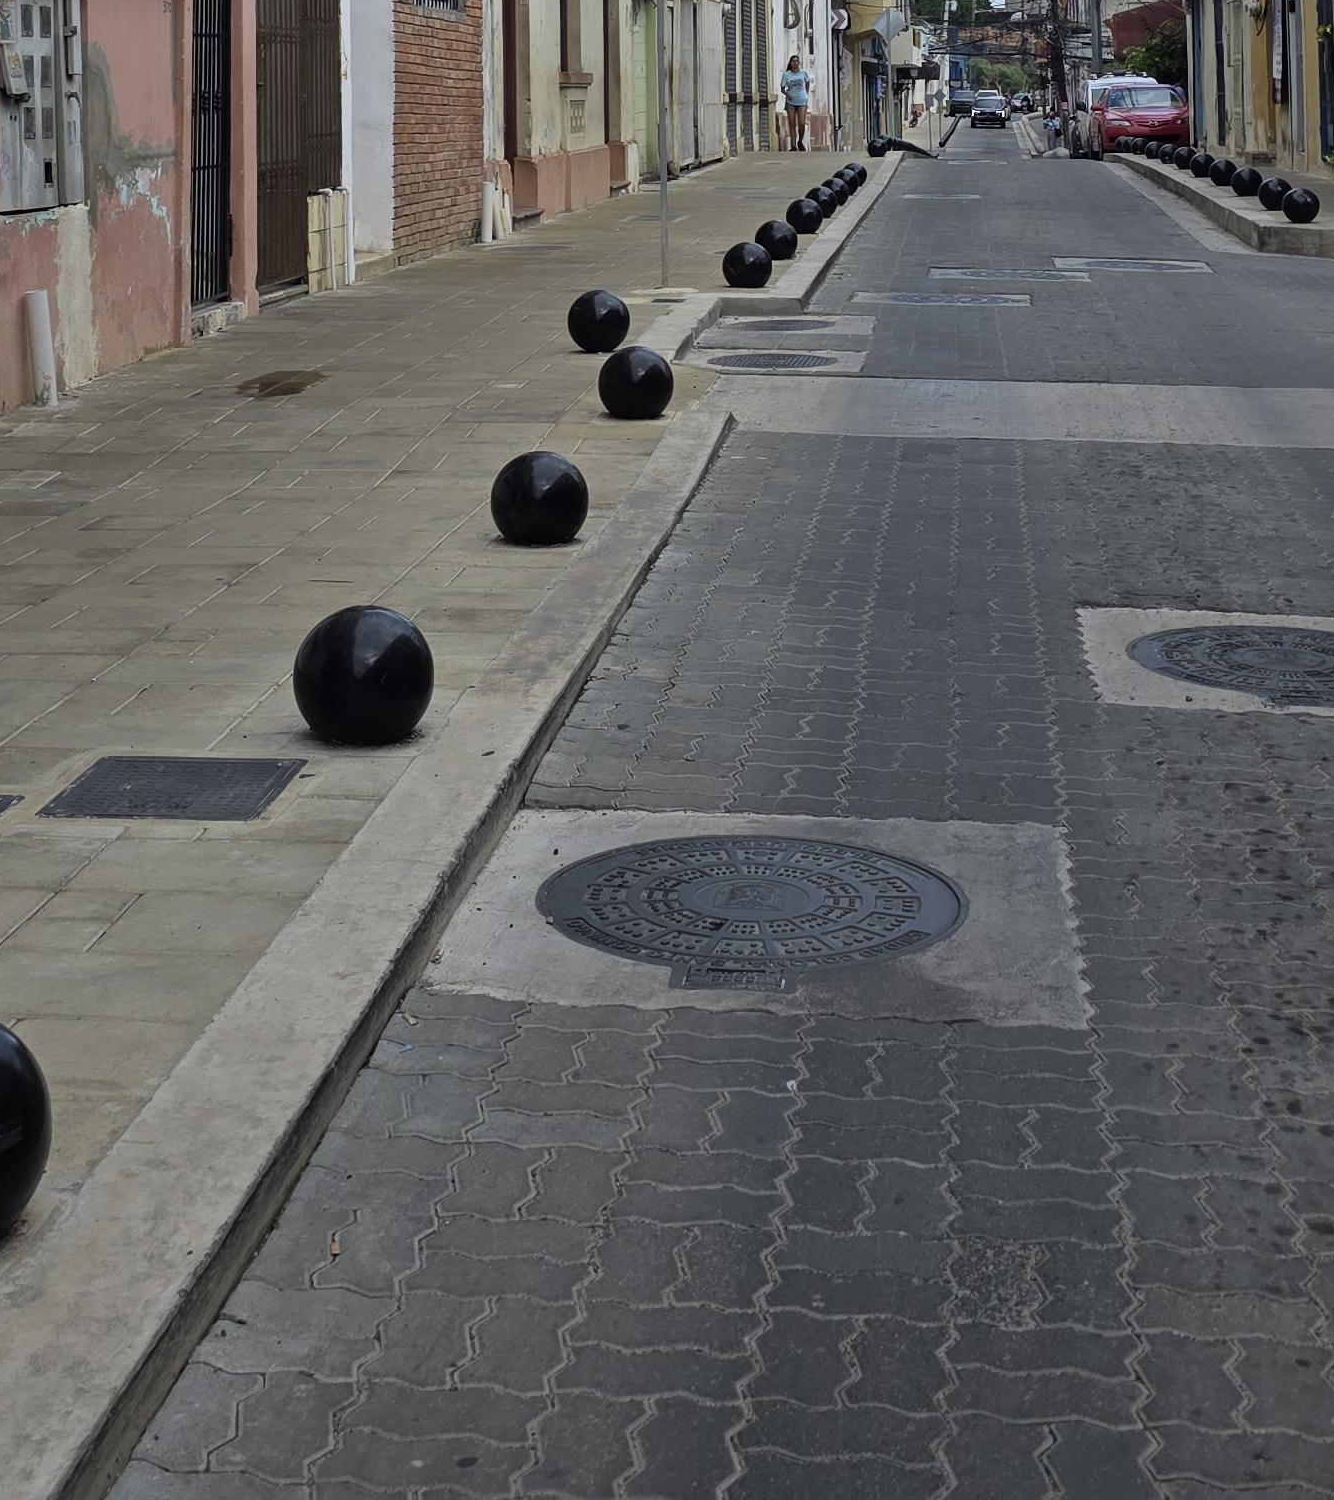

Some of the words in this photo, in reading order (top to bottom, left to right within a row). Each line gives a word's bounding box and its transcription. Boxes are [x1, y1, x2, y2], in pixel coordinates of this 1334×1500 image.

[859, 931, 929, 957] CIUDAD
[648, 948, 725, 968] SANTO
[732, 953, 851, 970] COLONIAL
